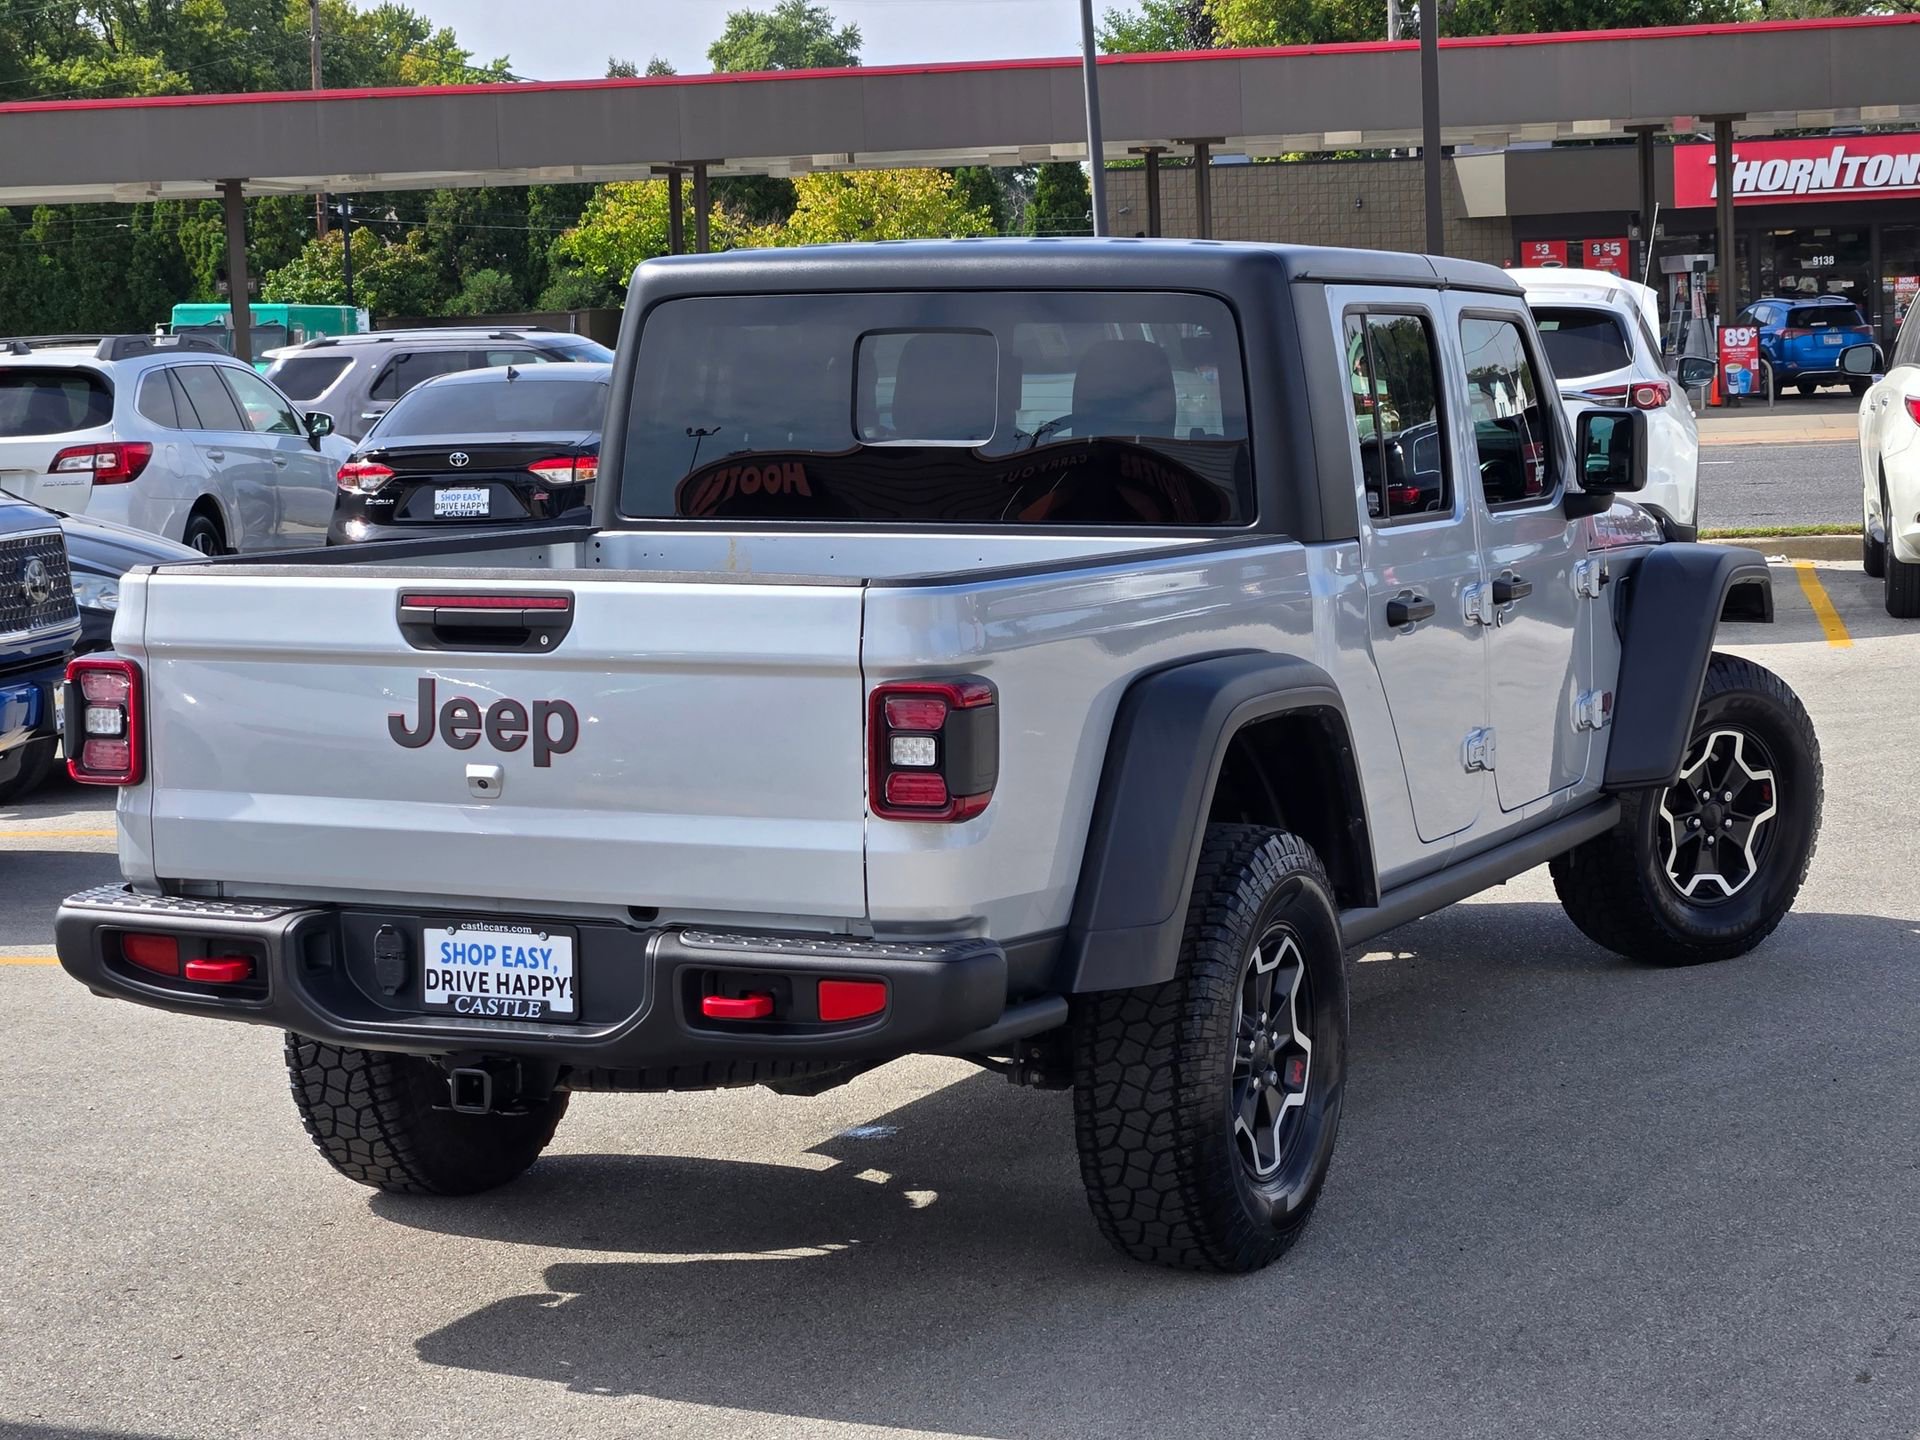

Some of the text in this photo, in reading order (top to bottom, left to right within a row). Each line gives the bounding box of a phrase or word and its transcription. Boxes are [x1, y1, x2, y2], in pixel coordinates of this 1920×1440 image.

[1709, 145, 1920, 198] HORNTON
[1631, 227, 1639, 237] 6
[1655, 227, 1662, 236] 5
[1535, 243, 1550, 255] $3
[1603, 242, 1621, 256] $5
[1812, 255, 1835, 266] 9138
[1898, 276, 1916, 285] NOW
[1894, 283, 1919, 291] HIRING!
[440, 493, 462, 502] SHOP
[434, 501, 490, 511] DRIVE HAPPY!
[387, 677, 579, 768] Jeep
[460, 921, 533, 935] castlecars.com
[440, 941, 559, 976] SHOP EASY,
[425, 967, 574, 999] DRIVE HAPPY!
[454, 995, 542, 1019] CASTLE
